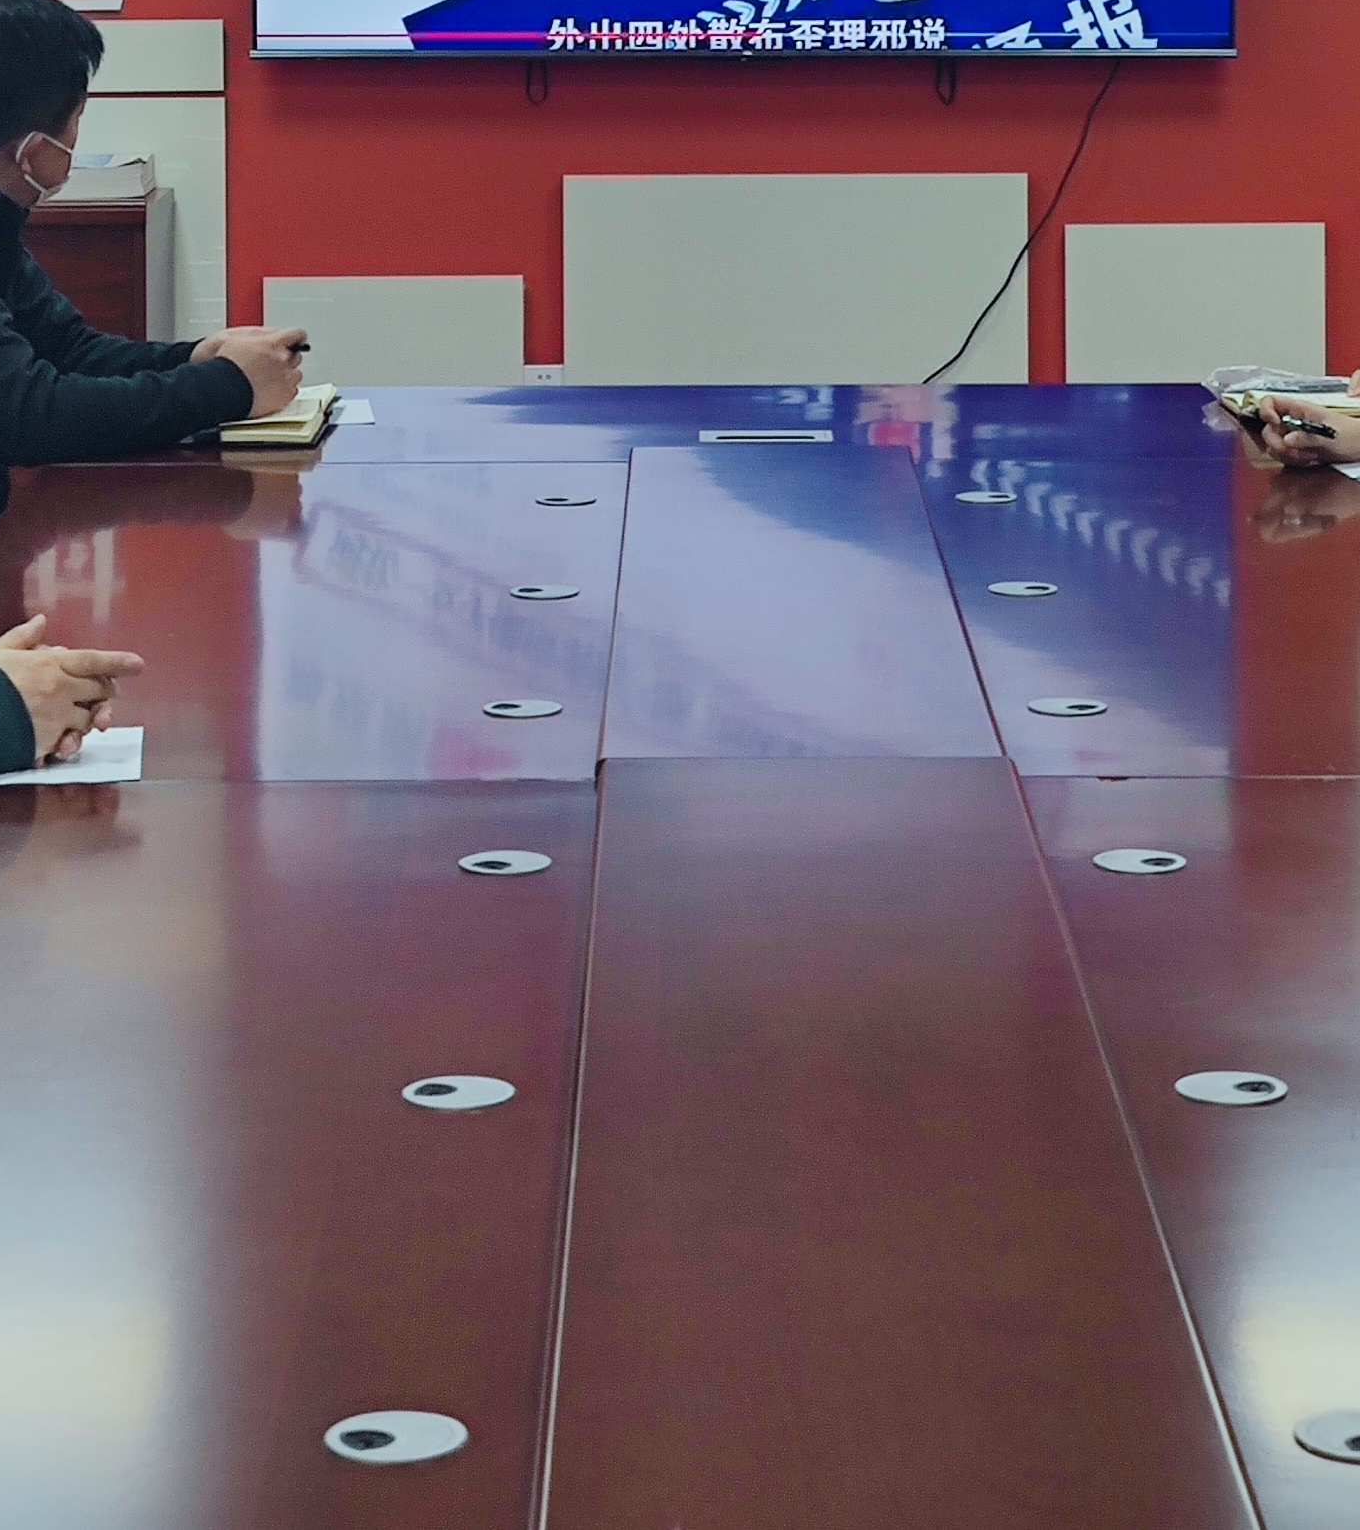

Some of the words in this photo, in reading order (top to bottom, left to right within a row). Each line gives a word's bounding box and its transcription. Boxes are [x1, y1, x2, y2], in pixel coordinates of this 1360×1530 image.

[546, 18, 947, 50] 外出四处散布歪理邪说
